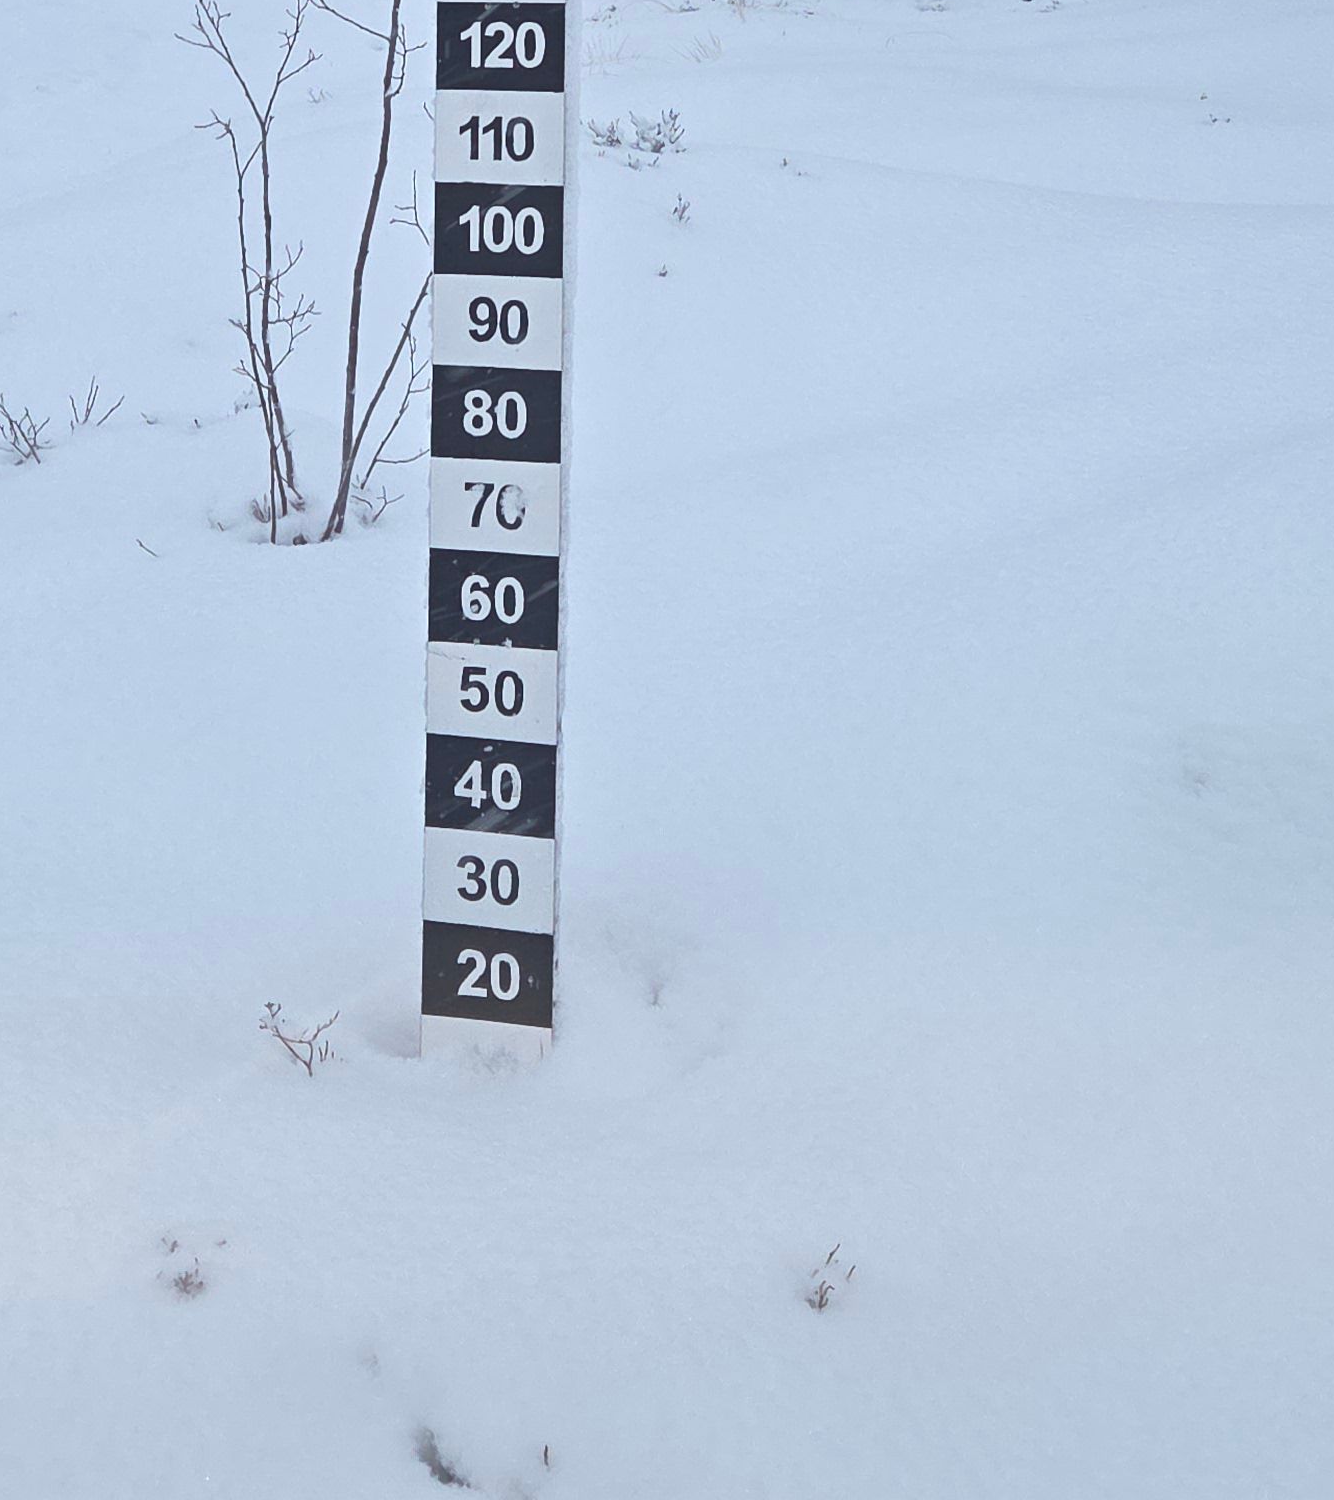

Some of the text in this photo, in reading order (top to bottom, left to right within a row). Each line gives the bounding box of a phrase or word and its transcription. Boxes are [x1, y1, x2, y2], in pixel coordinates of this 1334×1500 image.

[460, 20, 546, 69] 120
[459, 115, 535, 162] 110
[458, 205, 545, 256] 100
[468, 296, 530, 345] 90
[463, 389, 528, 439] 80
[464, 481, 526, 531] 70
[461, 574, 525, 625] 60
[460, 666, 524, 717] 50
[453, 759, 522, 811] 40
[456, 855, 520, 906] 30
[457, 948, 521, 1001] 20
